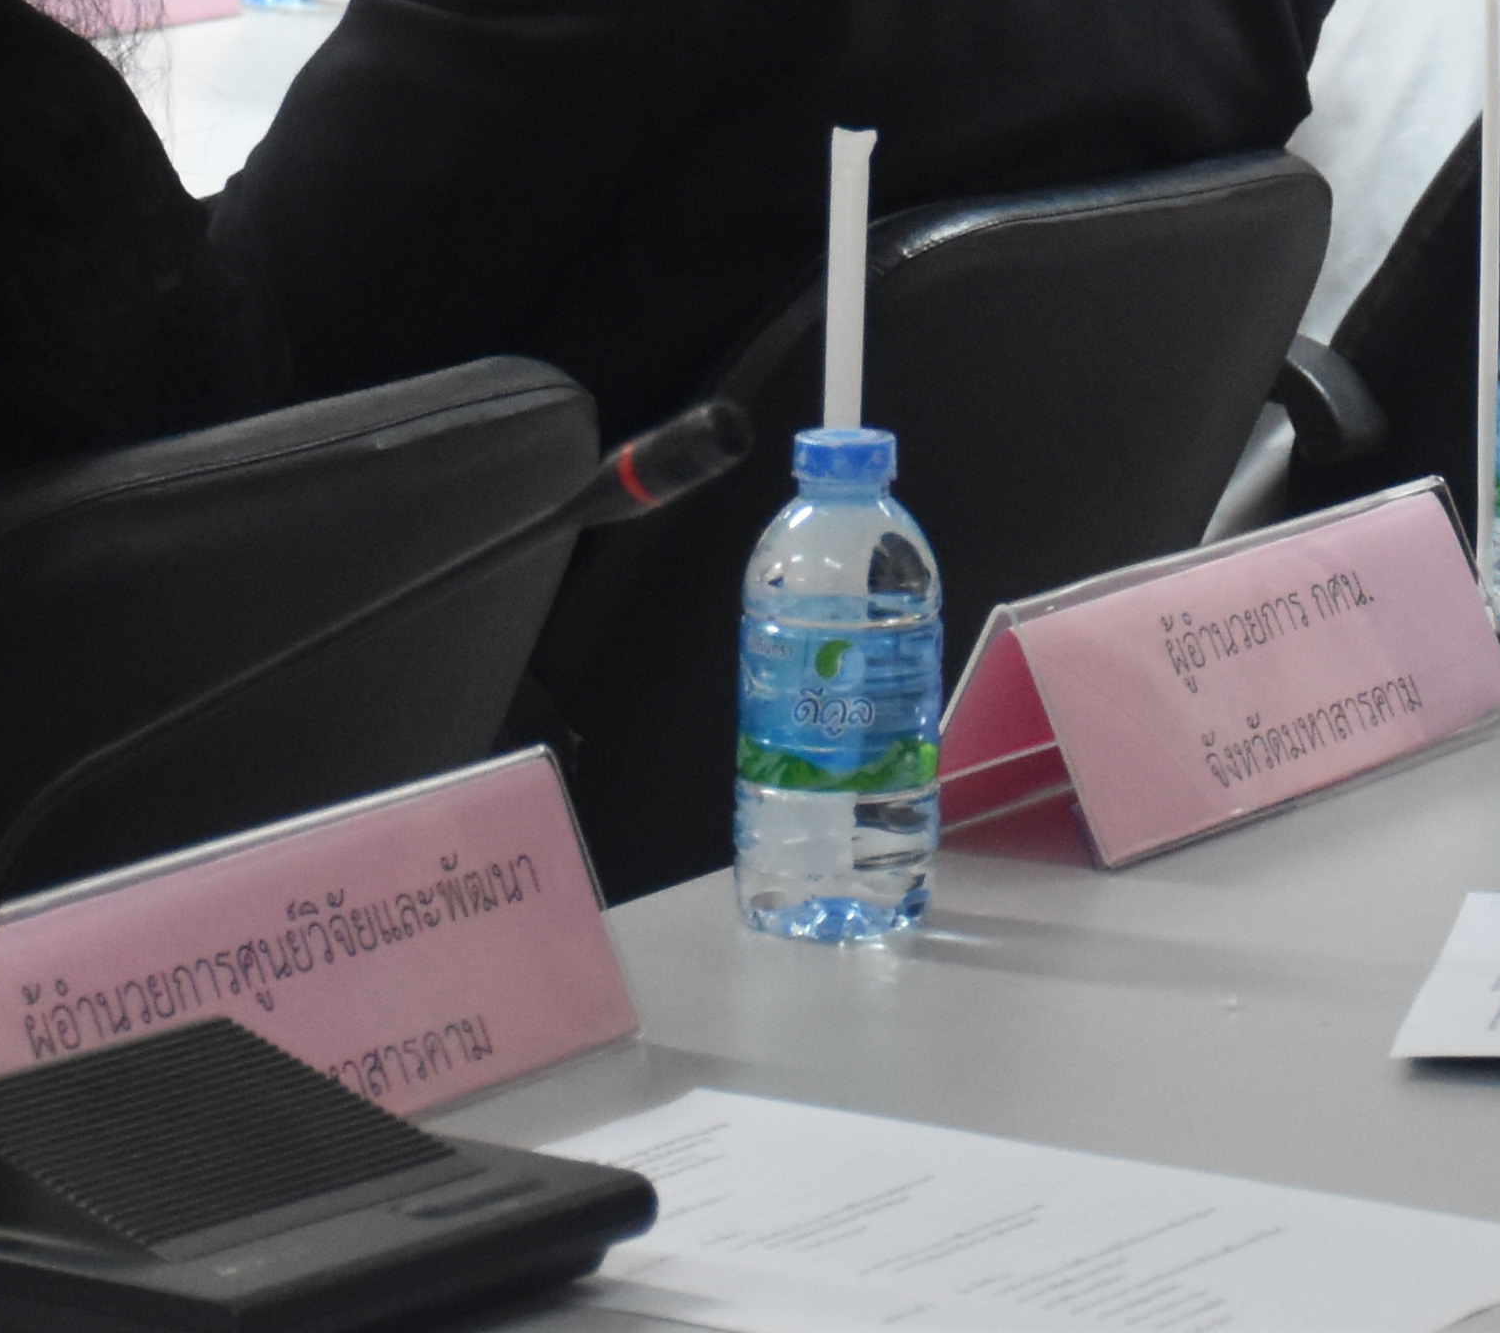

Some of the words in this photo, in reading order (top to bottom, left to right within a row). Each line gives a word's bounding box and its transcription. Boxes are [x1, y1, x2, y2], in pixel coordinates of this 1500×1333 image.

[1160, 591, 1310, 694] ผู้อำนวยการ
[1311, 571, 1375, 620] กศน.
[791, 686, 875, 737] ดีคูล
[1200, 674, 1423, 788] จังหวัดมหาสารคาม
[22, 853, 542, 1061] ผ้อำนวยการศูนย์วิจัยและพัฒนา
